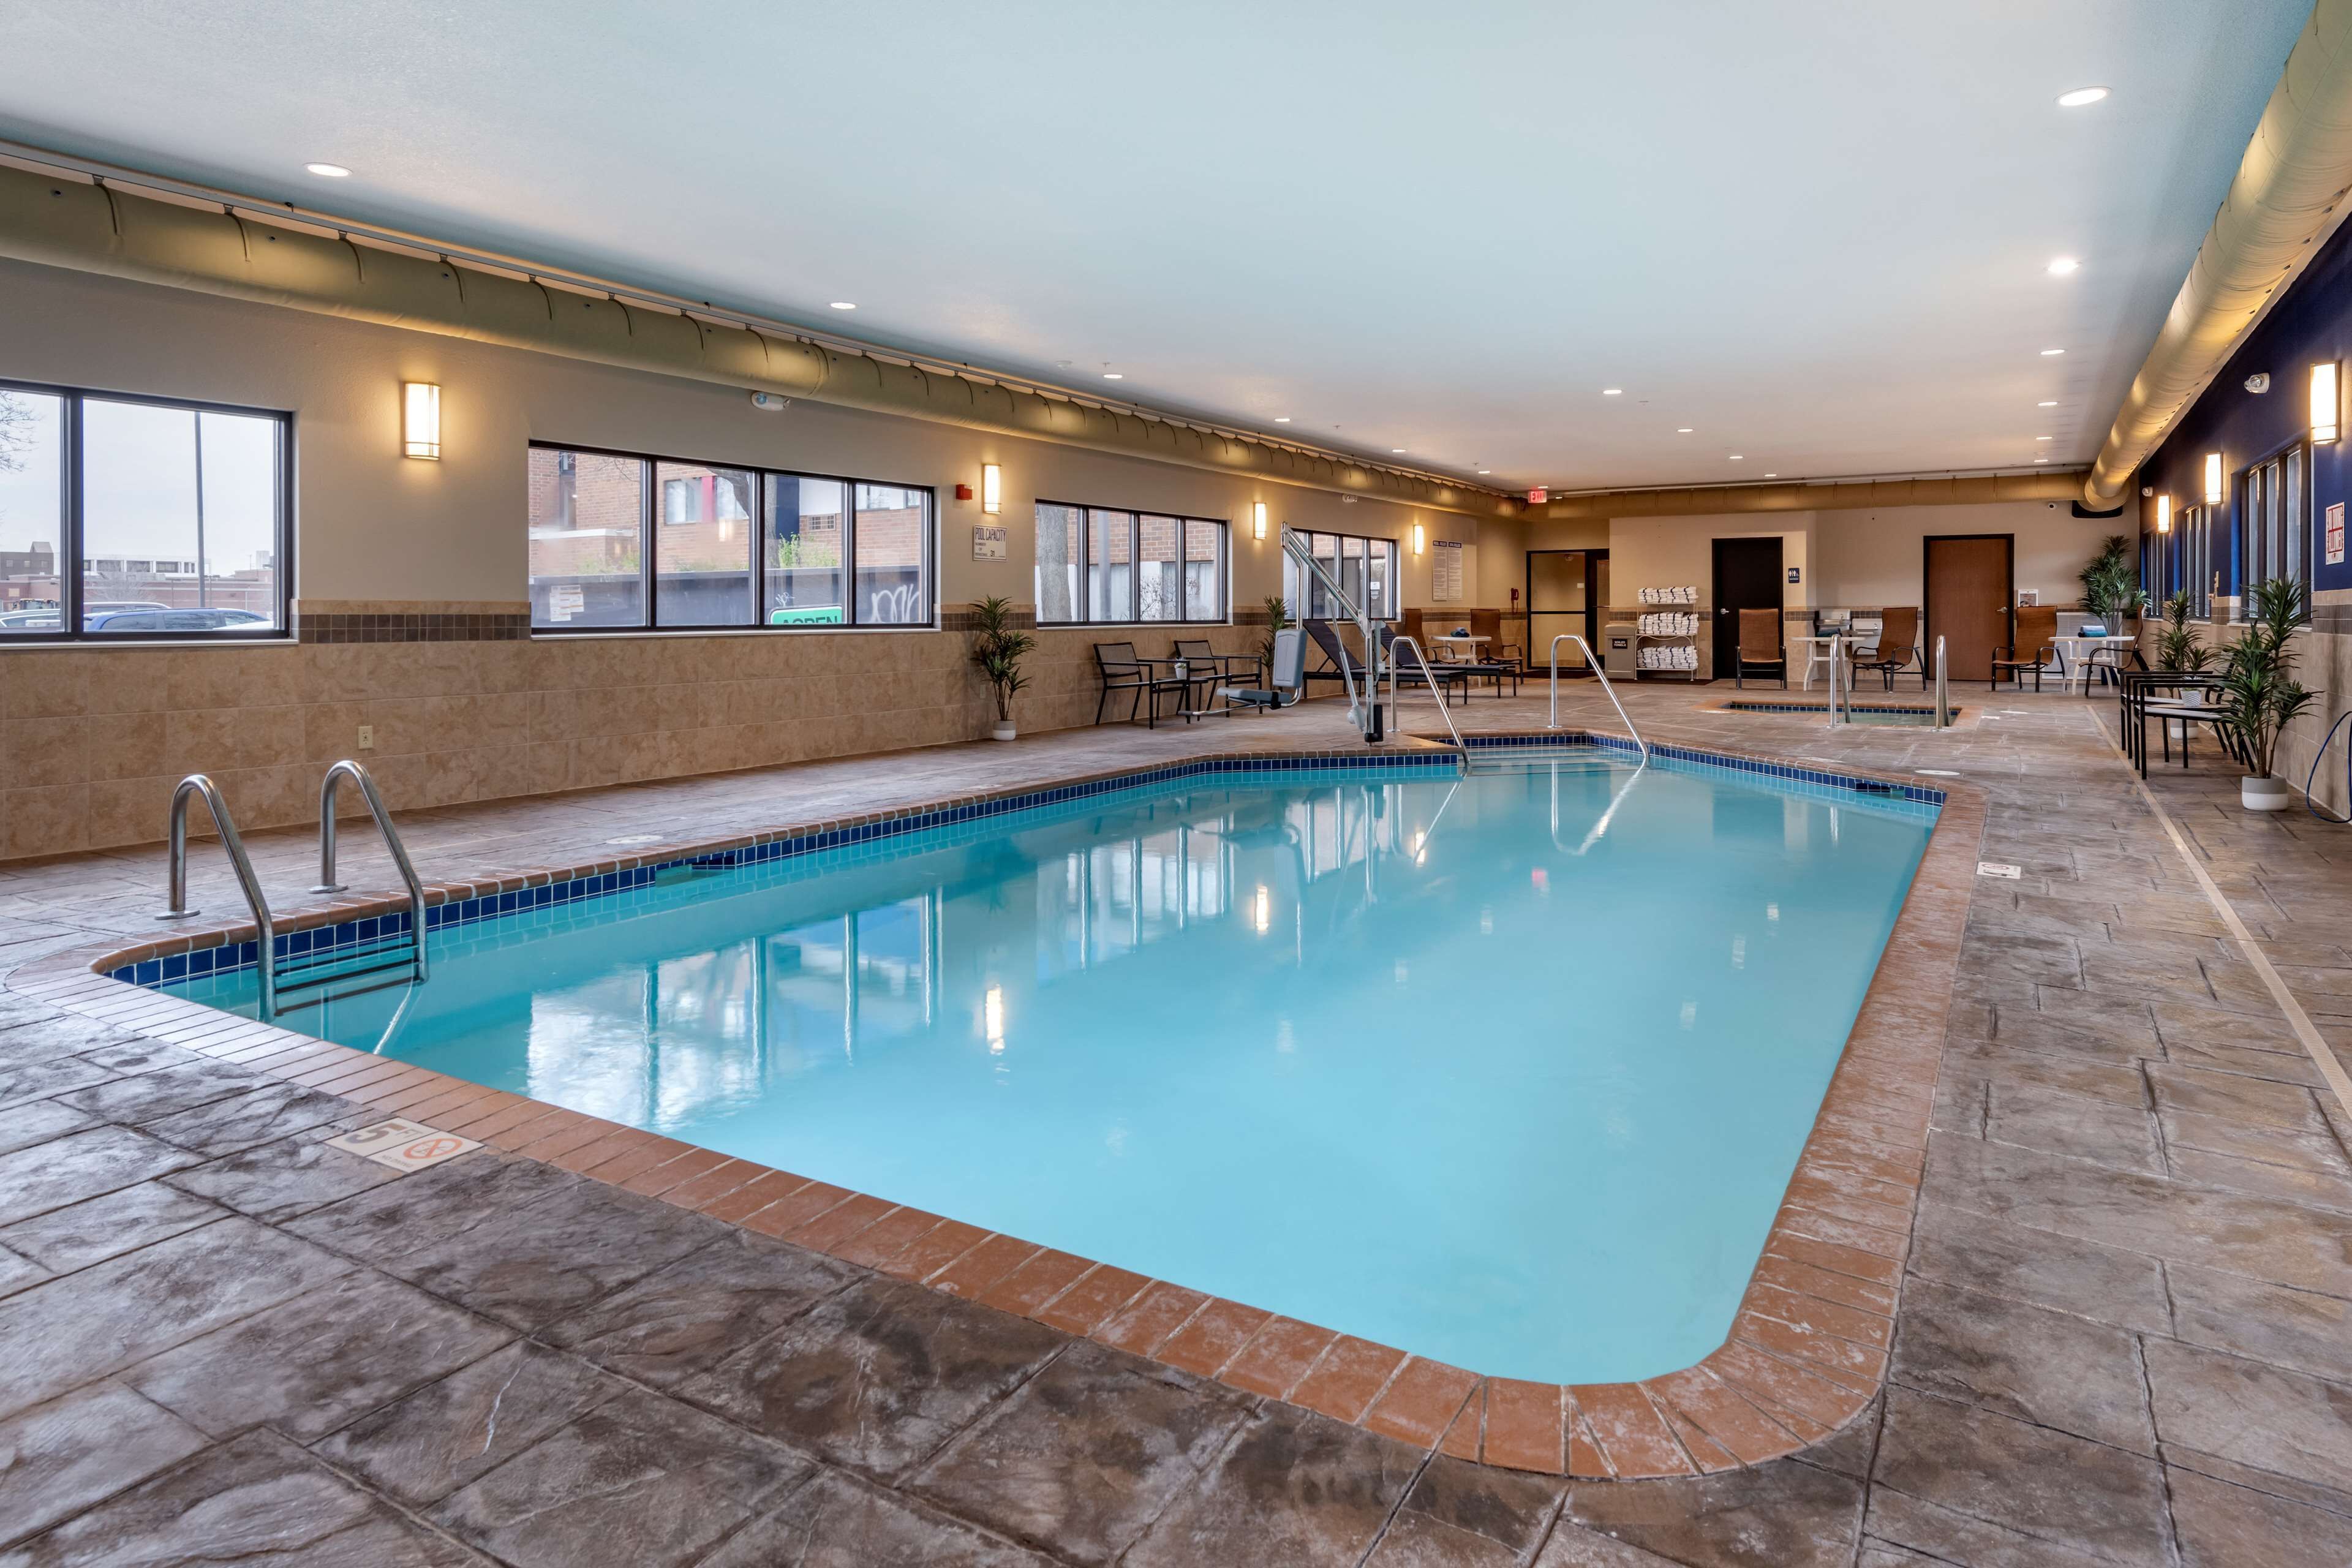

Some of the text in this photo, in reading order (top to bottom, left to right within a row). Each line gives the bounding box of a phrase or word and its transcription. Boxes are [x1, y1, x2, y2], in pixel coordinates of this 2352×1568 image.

[1531, 491, 1544, 502] EXIT
[976, 527, 1005, 542] POOL CAPACITY
[345, 1123, 407, 1144] 5
